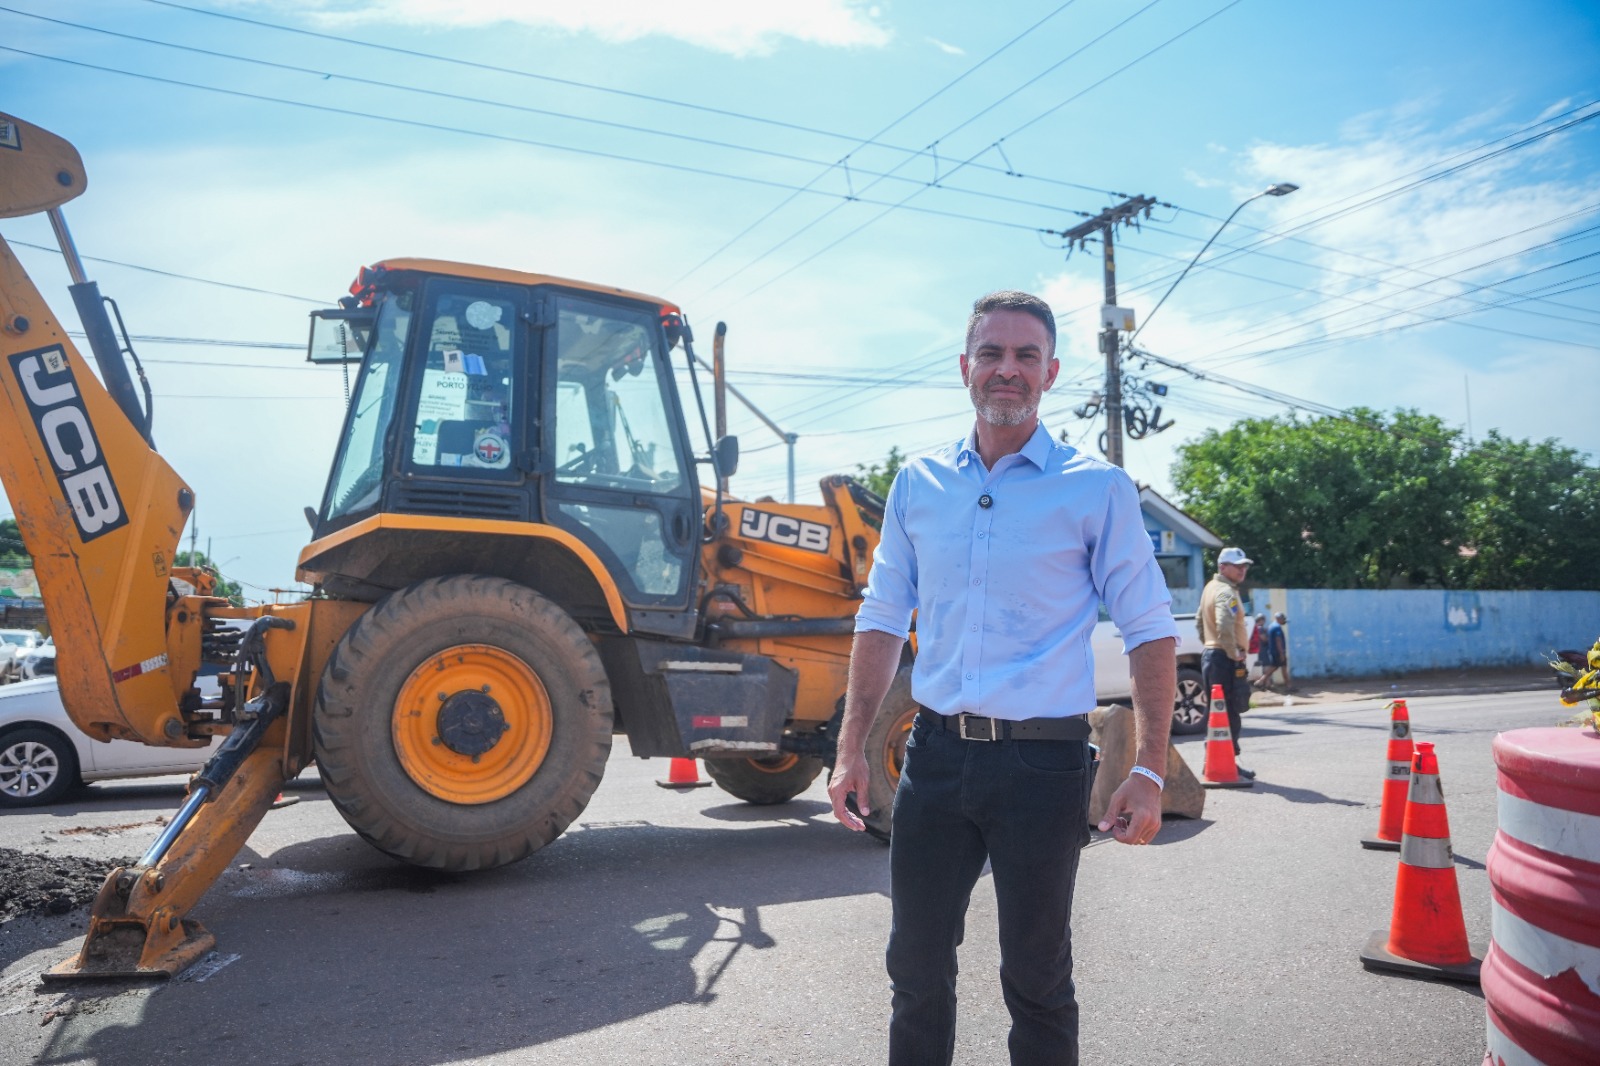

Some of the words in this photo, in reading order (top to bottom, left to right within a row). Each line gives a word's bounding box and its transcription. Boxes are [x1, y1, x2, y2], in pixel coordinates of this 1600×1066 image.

[436, 381, 465, 390] PORTO
[18, 355, 120, 534] JCB
[741, 512, 829, 551] JCB
